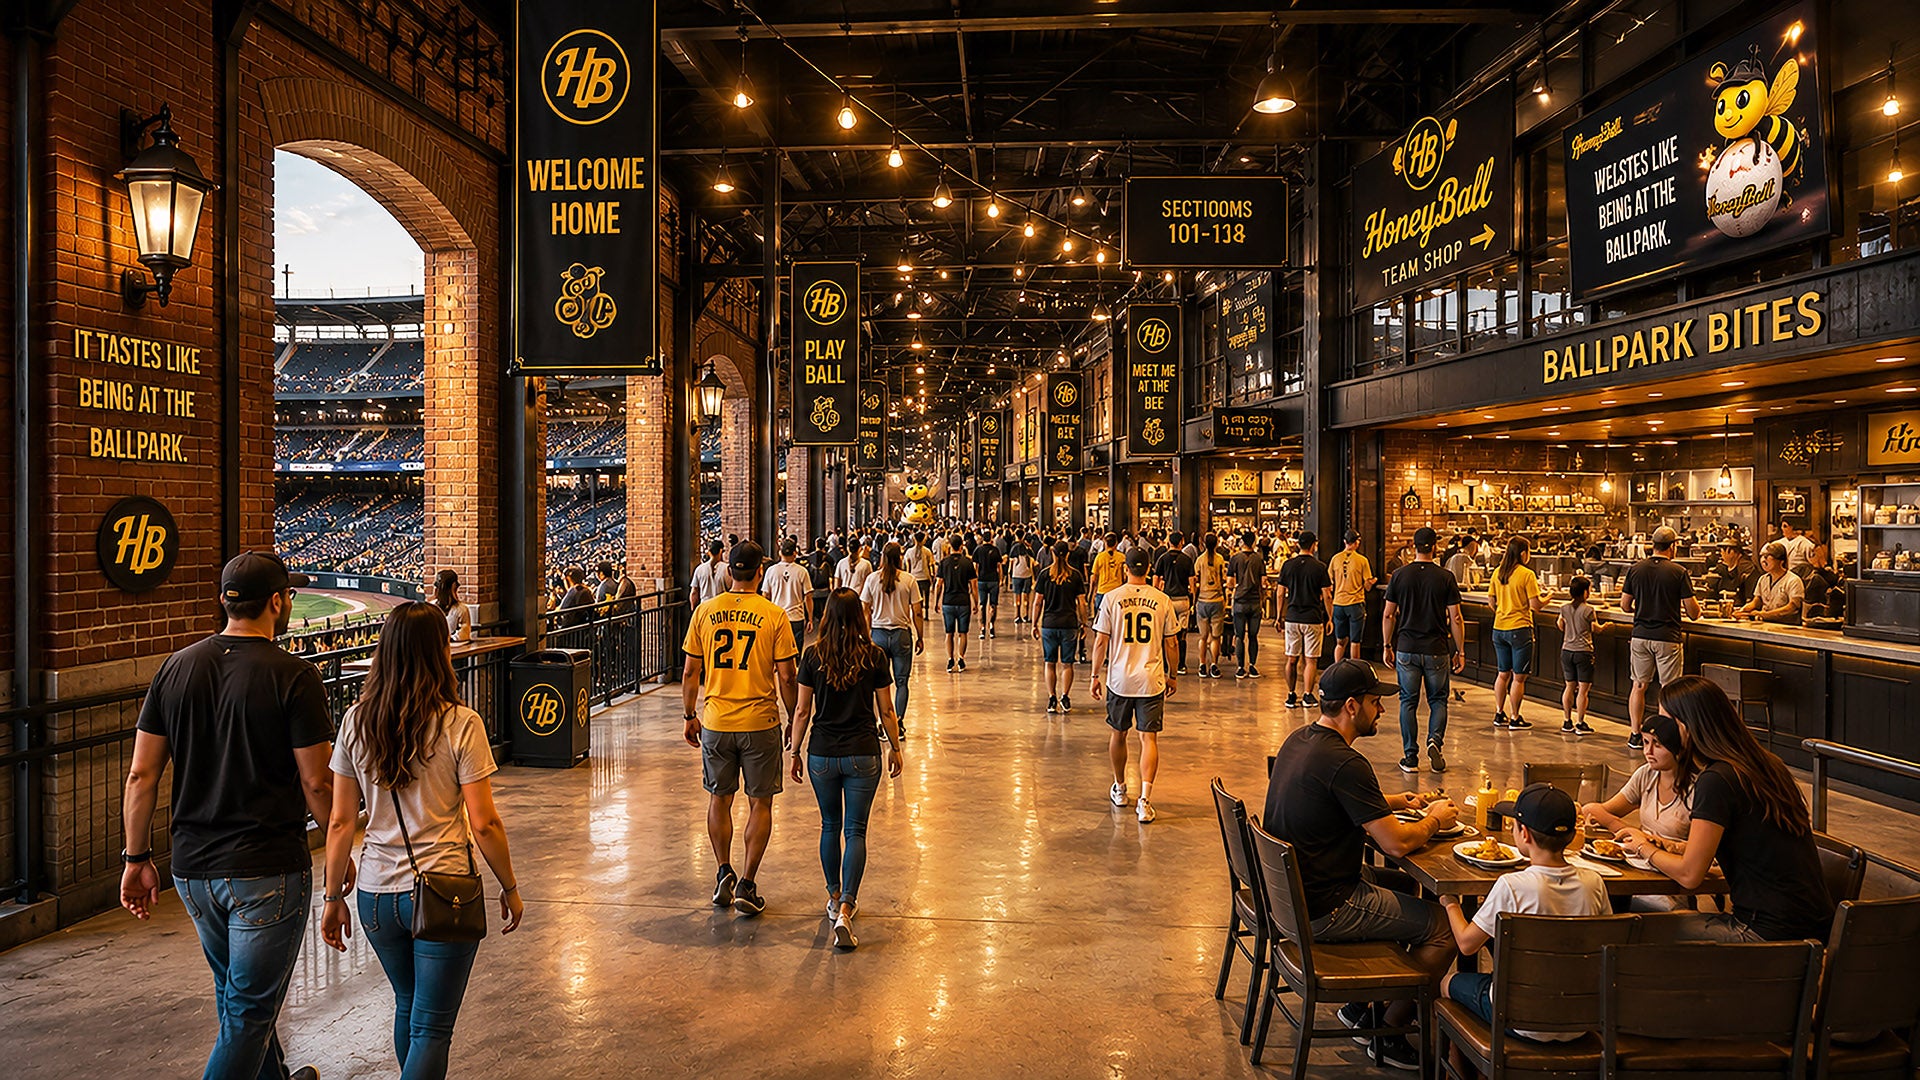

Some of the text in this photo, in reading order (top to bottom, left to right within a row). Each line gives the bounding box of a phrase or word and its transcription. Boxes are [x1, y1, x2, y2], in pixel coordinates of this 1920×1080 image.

[555, 47, 617, 109] HB
[1409, 128, 1439, 179] HB
[1594, 134, 1679, 195] WELSTES LIKE
[527, 157, 645, 192] WELCOME
[551, 201, 620, 235] HOME
[1161, 199, 1253, 218] SECTIOOMS
[1598, 176, 1676, 231] BEING AT THE
[1606, 219, 1671, 265] BALLPARK.
[1382, 240, 1463, 288] TEAM SHOP
[810, 287, 841, 318] HB
[74, 328, 201, 375] IT TASTES LIKE
[805, 339, 846, 360] PLAY
[1543, 290, 1823, 384] BALLPARK BITES
[805, 364, 846, 385] BALL
[1132, 363, 1176, 377] MEET ME
[1138, 379, 1170, 393] AT THE
[79, 377, 196, 418] BEING AT THE
[1144, 396, 1165, 410] BEE
[90, 426, 189, 463] BALLPARK.
[113, 514, 167, 574] HB
[1124, 611, 1153, 643] 16
[714, 628, 757, 671] 27
[527, 692, 559, 728] HB
